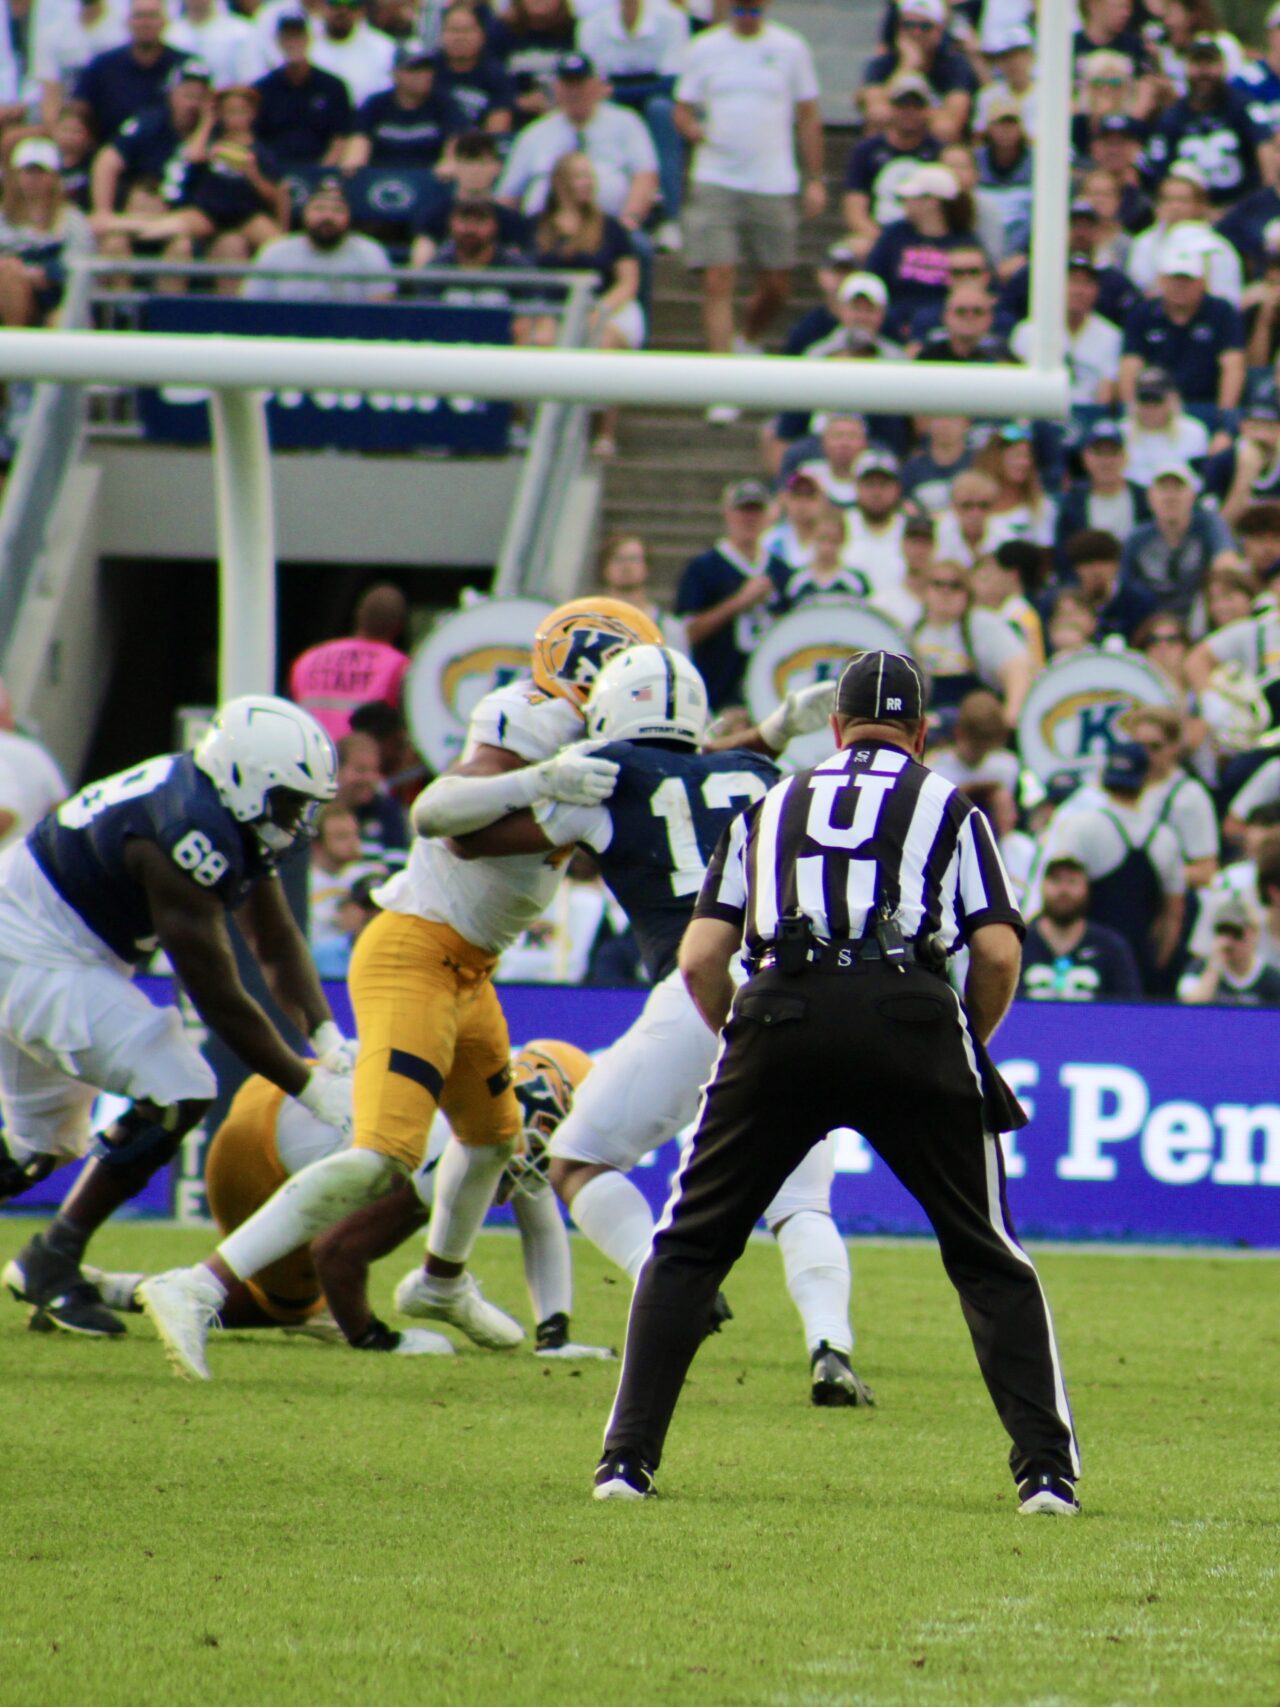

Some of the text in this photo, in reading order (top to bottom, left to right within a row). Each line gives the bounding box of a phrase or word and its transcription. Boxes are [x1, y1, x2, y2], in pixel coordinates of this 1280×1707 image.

[886, 697, 902, 711] RR
[1075, 703, 1129, 757] K
[806, 774, 896, 849] U
[172, 829, 228, 886] 68
